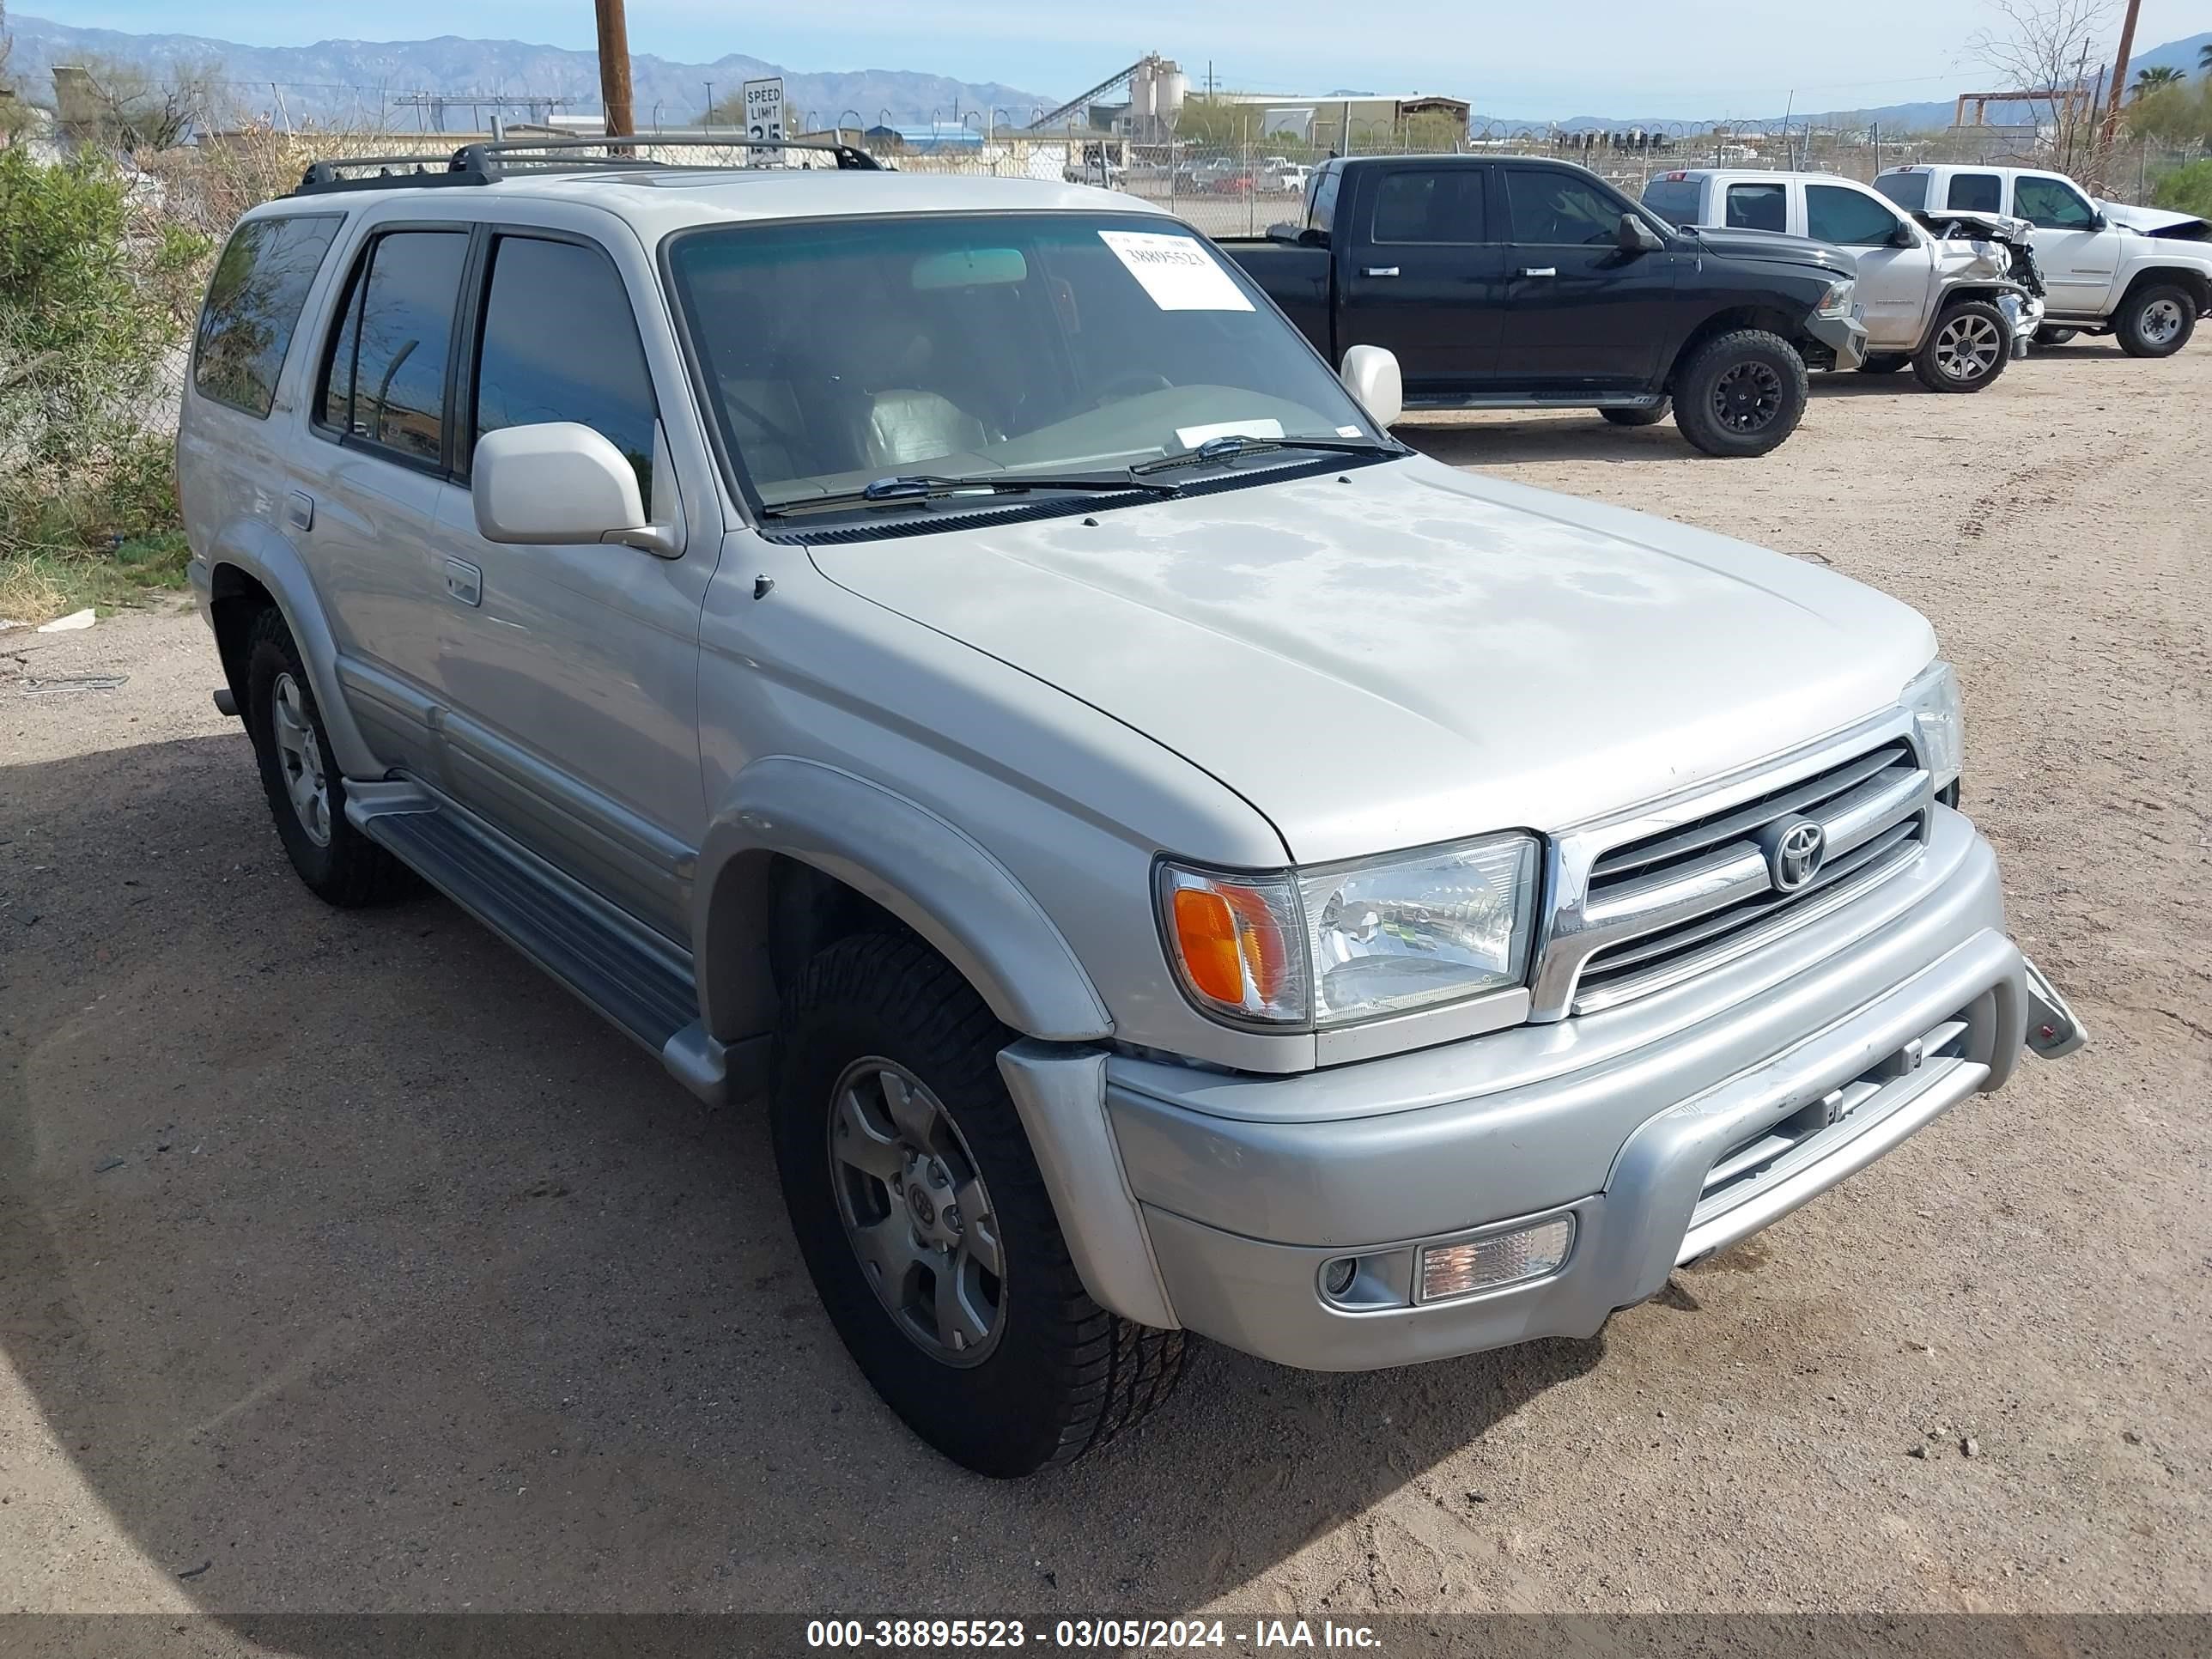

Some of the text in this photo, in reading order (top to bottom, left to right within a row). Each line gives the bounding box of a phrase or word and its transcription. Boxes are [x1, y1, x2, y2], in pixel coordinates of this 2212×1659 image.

[748, 88, 781, 103] SPEED
[751, 105, 777, 120] LIMIT
[1125, 249, 1206, 266] 38895523
